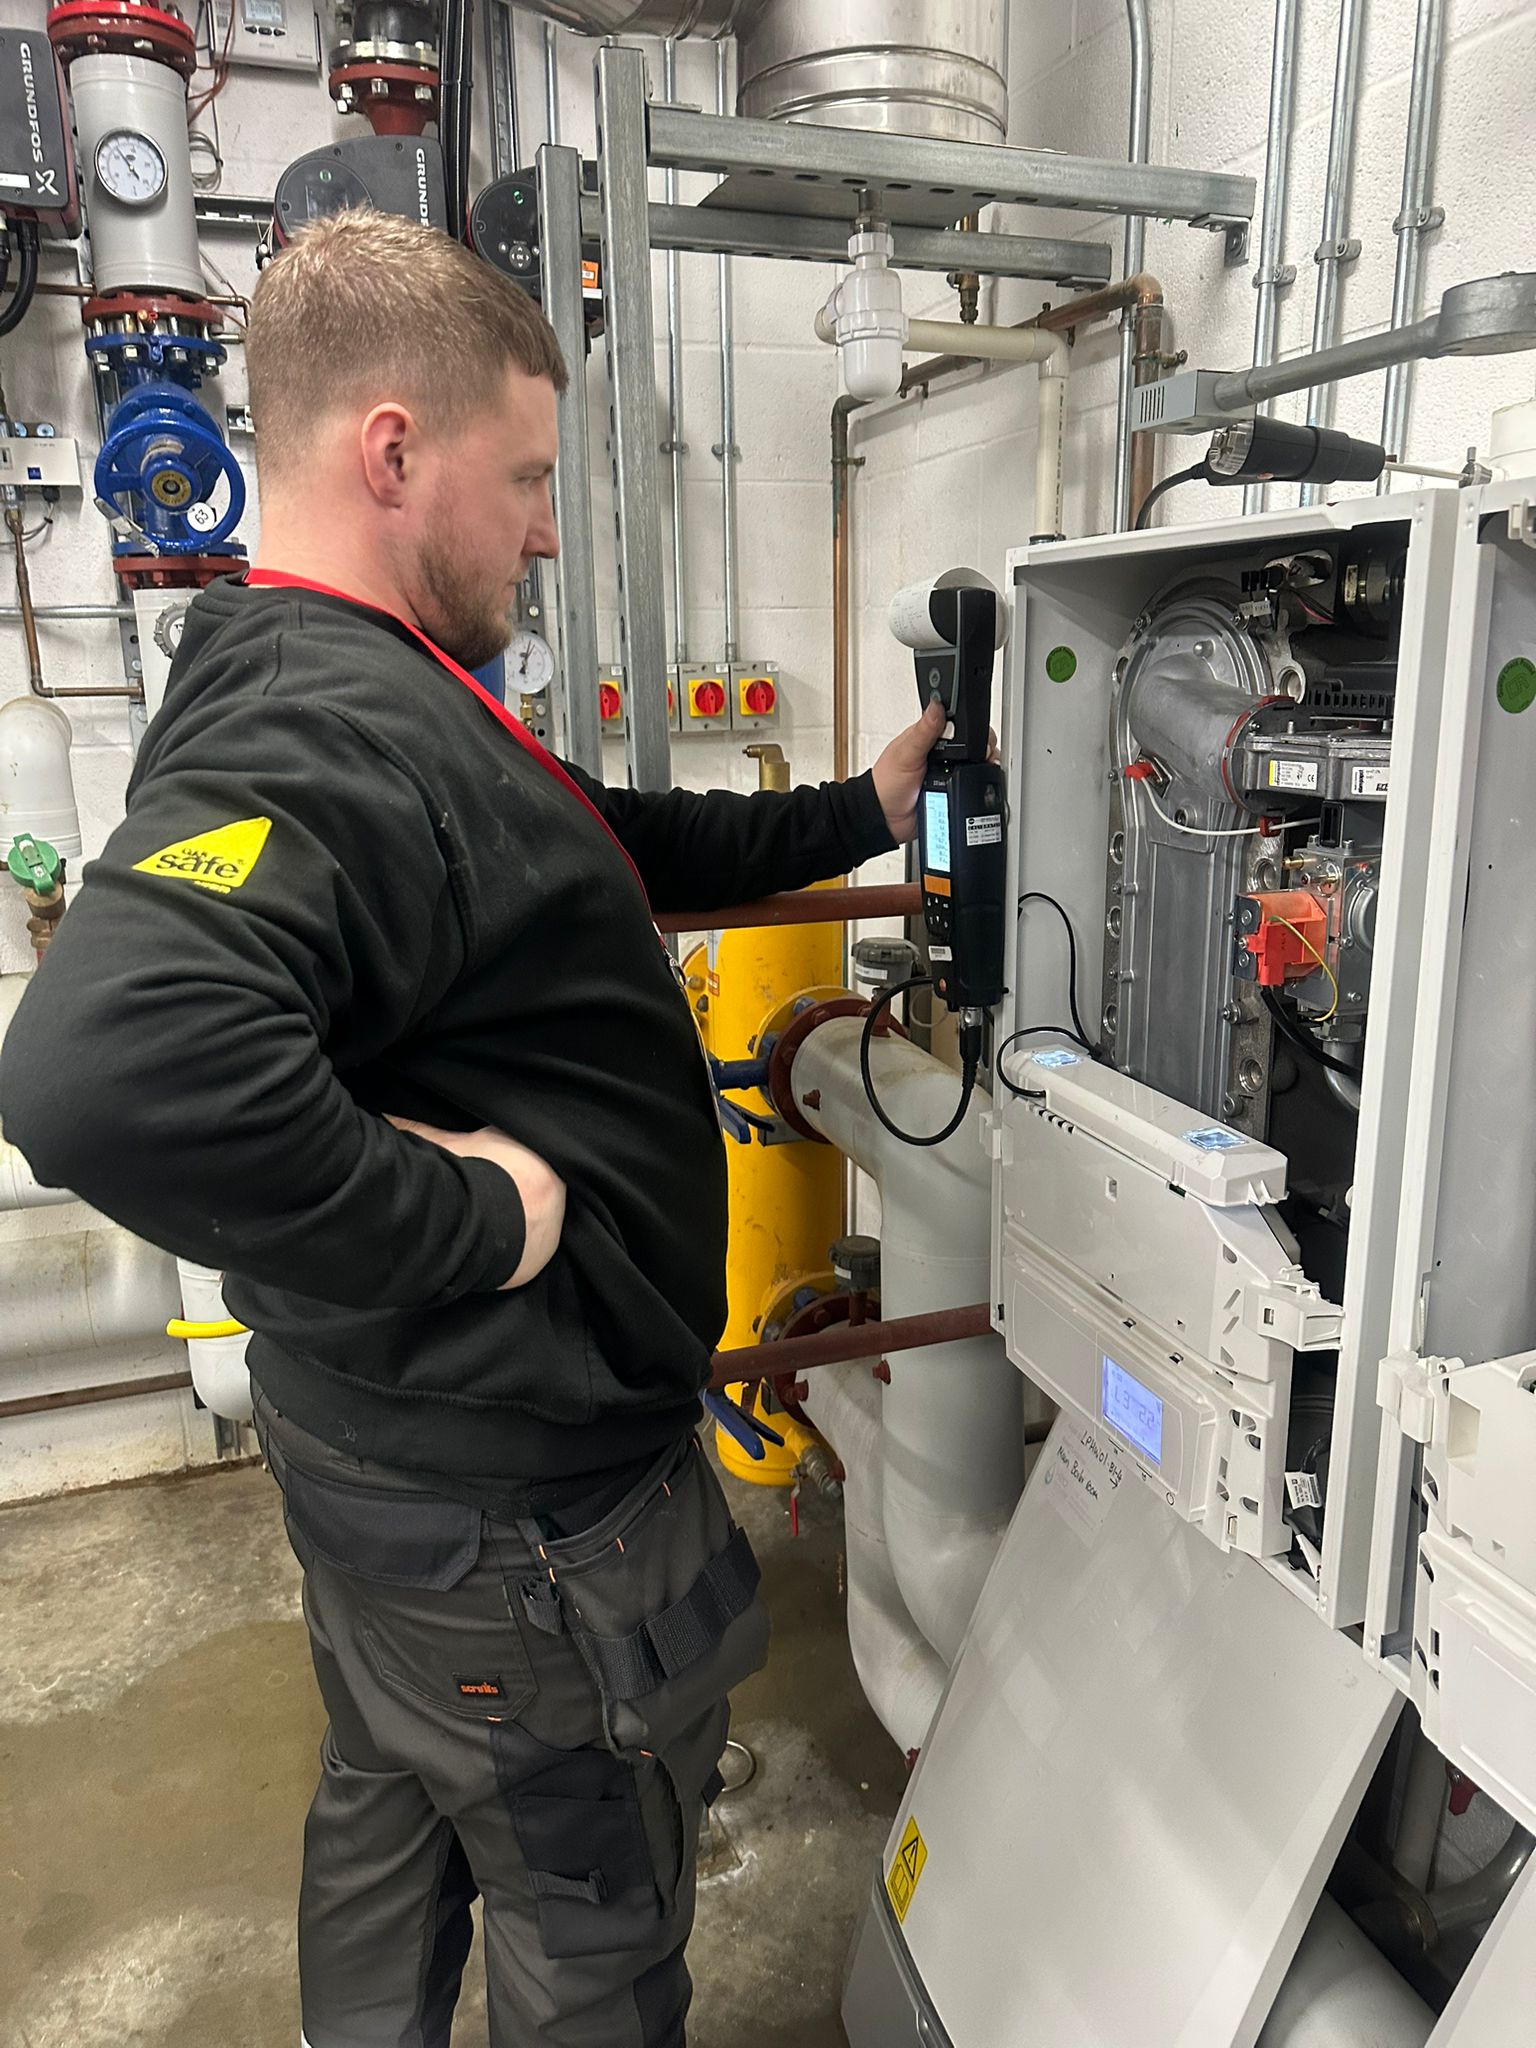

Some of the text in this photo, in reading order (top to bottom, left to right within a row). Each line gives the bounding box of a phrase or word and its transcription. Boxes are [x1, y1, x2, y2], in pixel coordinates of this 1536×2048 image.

[20, 42, 44, 164] GRUNDFOS
[416, 147, 430, 228] GRUNDF
[194, 508, 209, 525] 63
[156, 853, 239, 879] safe
